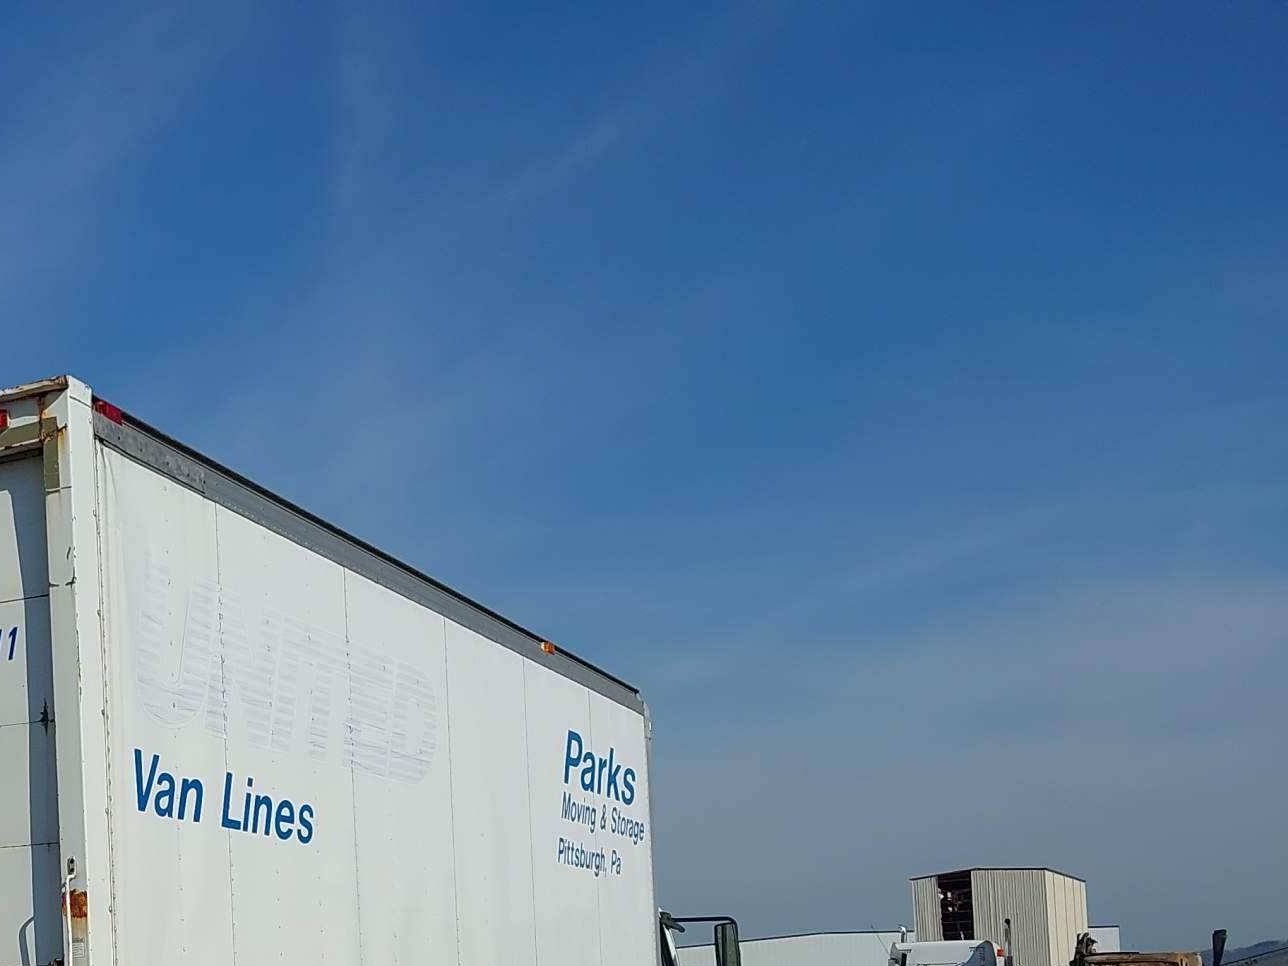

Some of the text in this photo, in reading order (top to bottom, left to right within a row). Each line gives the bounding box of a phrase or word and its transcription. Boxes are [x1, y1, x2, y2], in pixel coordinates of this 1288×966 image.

[133, 748, 314, 844] Van Lines
[563, 729, 637, 806] Parks
[561, 791, 645, 845] Moving & Storage
[611, 850, 622, 875] Pa
